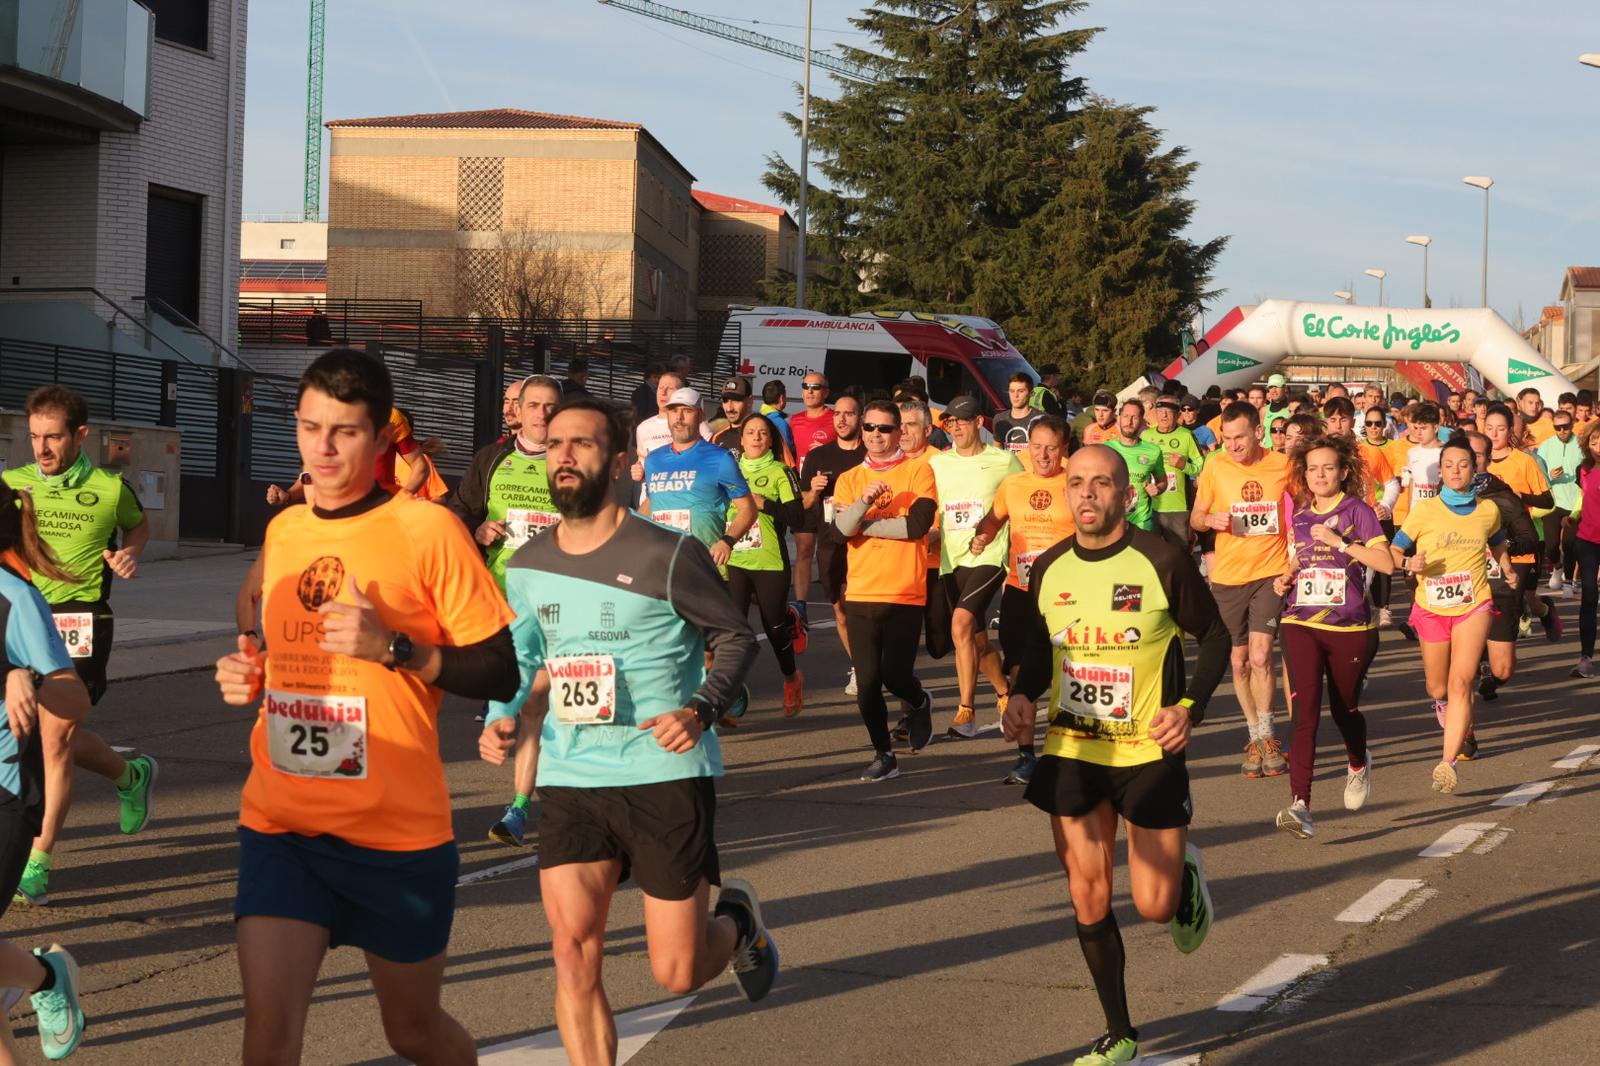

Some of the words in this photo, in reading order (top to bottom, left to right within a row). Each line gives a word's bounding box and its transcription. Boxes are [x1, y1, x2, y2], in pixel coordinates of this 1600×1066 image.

[807, 321, 875, 332] AMBULANCIA
[1303, 313, 1325, 337] El
[1327, 316, 1380, 341] Corte
[1383, 313, 1460, 350] Inglés
[759, 365, 784, 376] Cruz
[651, 471, 669, 481] WE
[670, 471, 696, 480] ARE
[649, 481, 694, 493] READY
[1418, 489, 1434, 498] 130
[955, 512, 969, 523] 59
[1242, 513, 1268, 527] 186
[39, 520, 81, 531] BAJOSA
[1436, 584, 1464, 600] 284
[283, 620, 326, 644] UPS
[588, 630, 631, 641] SEGOVIA
[1067, 626, 1125, 645] kike
[1062, 659, 1130, 683] bedunia
[562, 680, 599, 707] 263
[1070, 681, 1114, 706] 285
[267, 693, 363, 723] bedunia
[290, 724, 329, 757] 25
